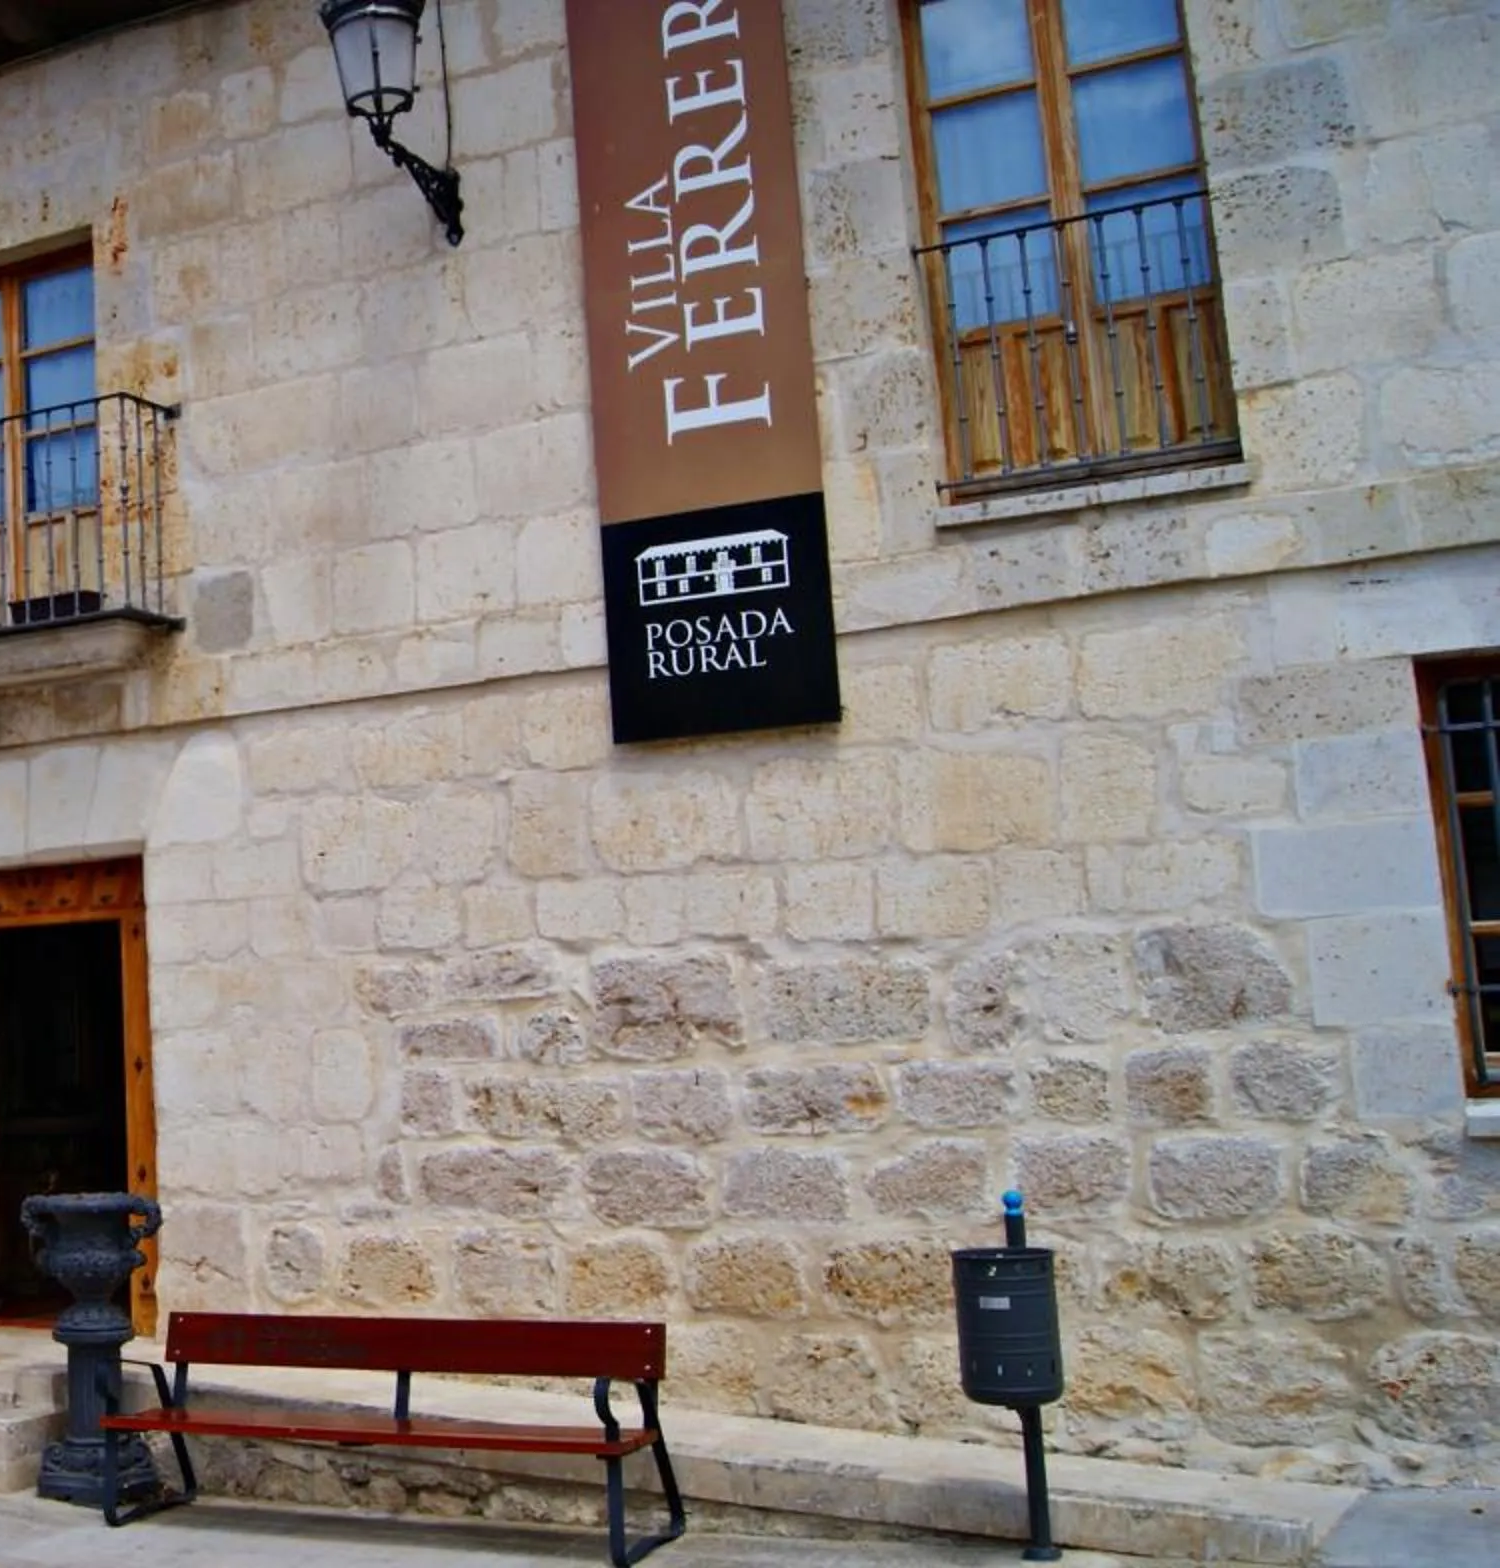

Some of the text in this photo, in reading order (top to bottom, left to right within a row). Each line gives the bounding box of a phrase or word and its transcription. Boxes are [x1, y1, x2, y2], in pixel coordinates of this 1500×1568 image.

[624, 174, 680, 371] VILLA
[645, 607, 795, 651] POSADA
[647, 639, 767, 679] RURAL
